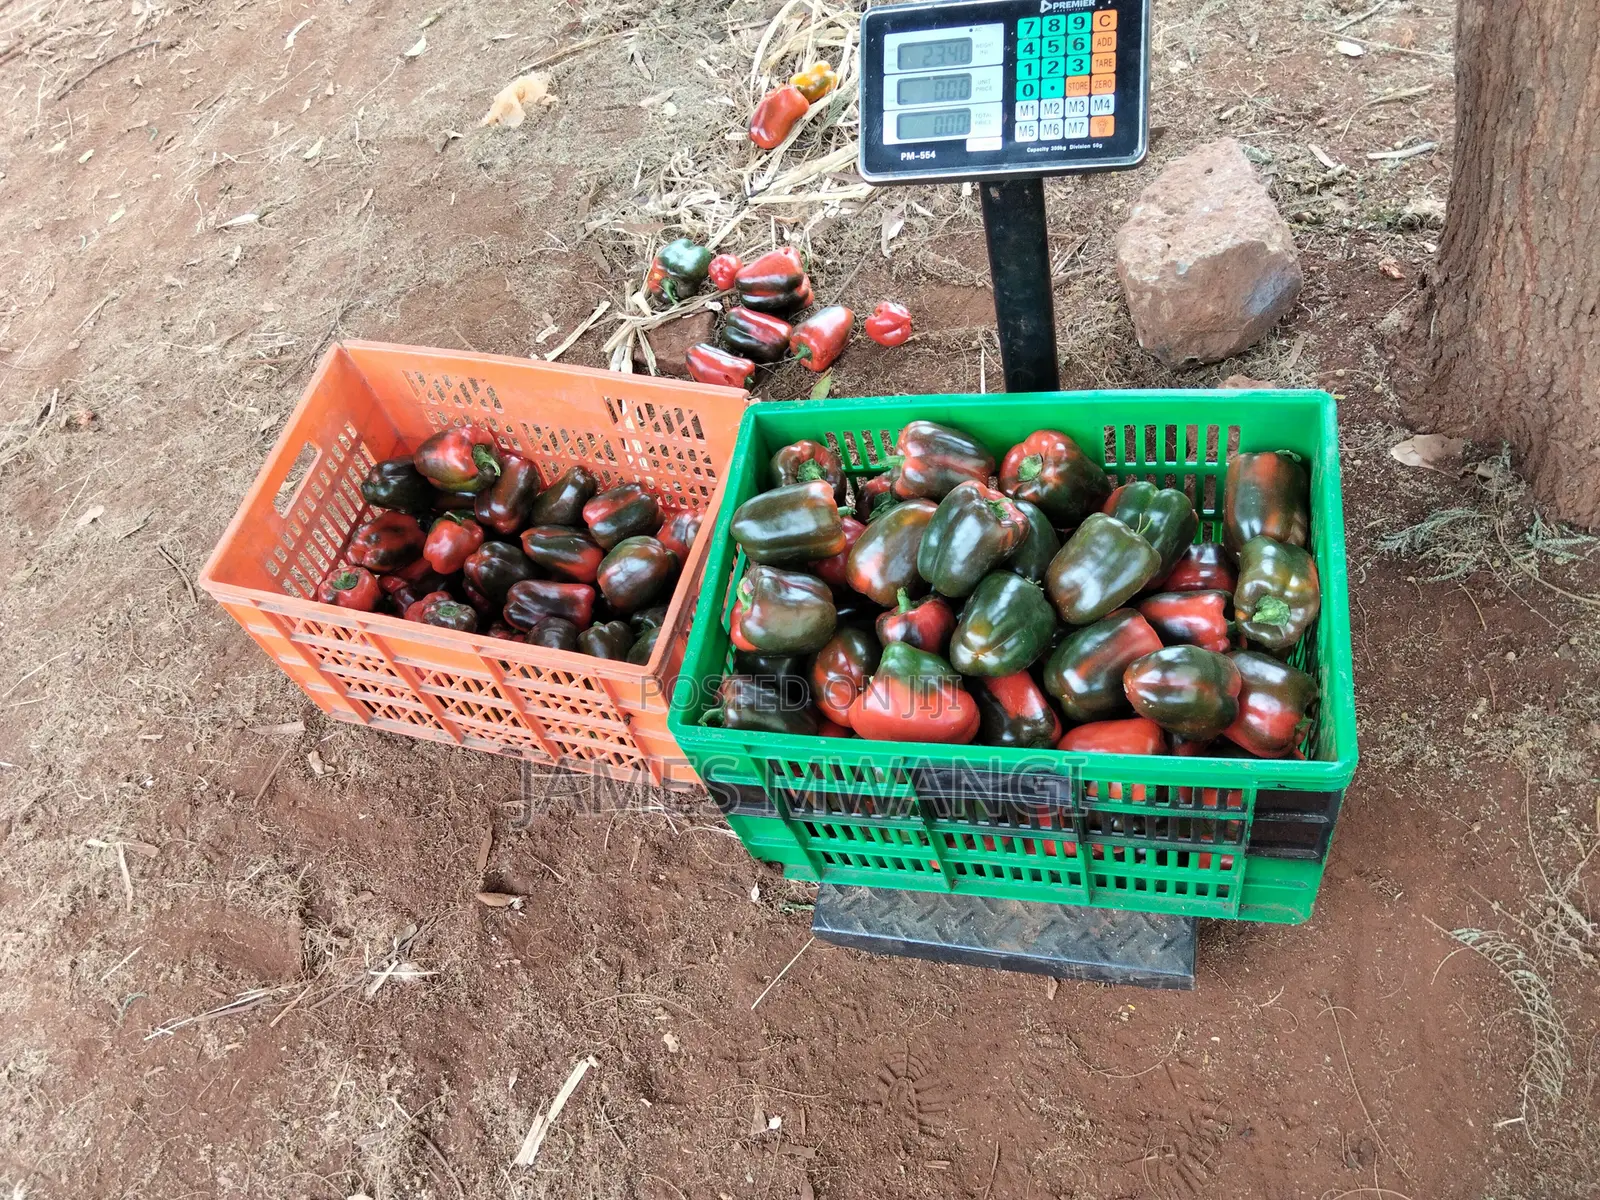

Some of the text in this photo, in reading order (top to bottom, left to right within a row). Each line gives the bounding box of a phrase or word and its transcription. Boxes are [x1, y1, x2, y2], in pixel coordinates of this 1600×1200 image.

[1053, 0, 1095, 9] PREMIER
[1024, 14, 1111, 35] 7 8 9 C
[1023, 37, 1112, 55] 4 5 6 ADD
[1024, 58, 1112, 76] 1 2 3 TARE
[1022, 83, 1034, 97] 0
[1068, 81, 1088, 91] STORE
[1094, 79, 1112, 89] ZERO
[1020, 99, 1110, 116] M1 M2 M3 M4
[1018, 122, 1084, 137] M5 M6 M7
[901, 150, 936, 160] PM-554
